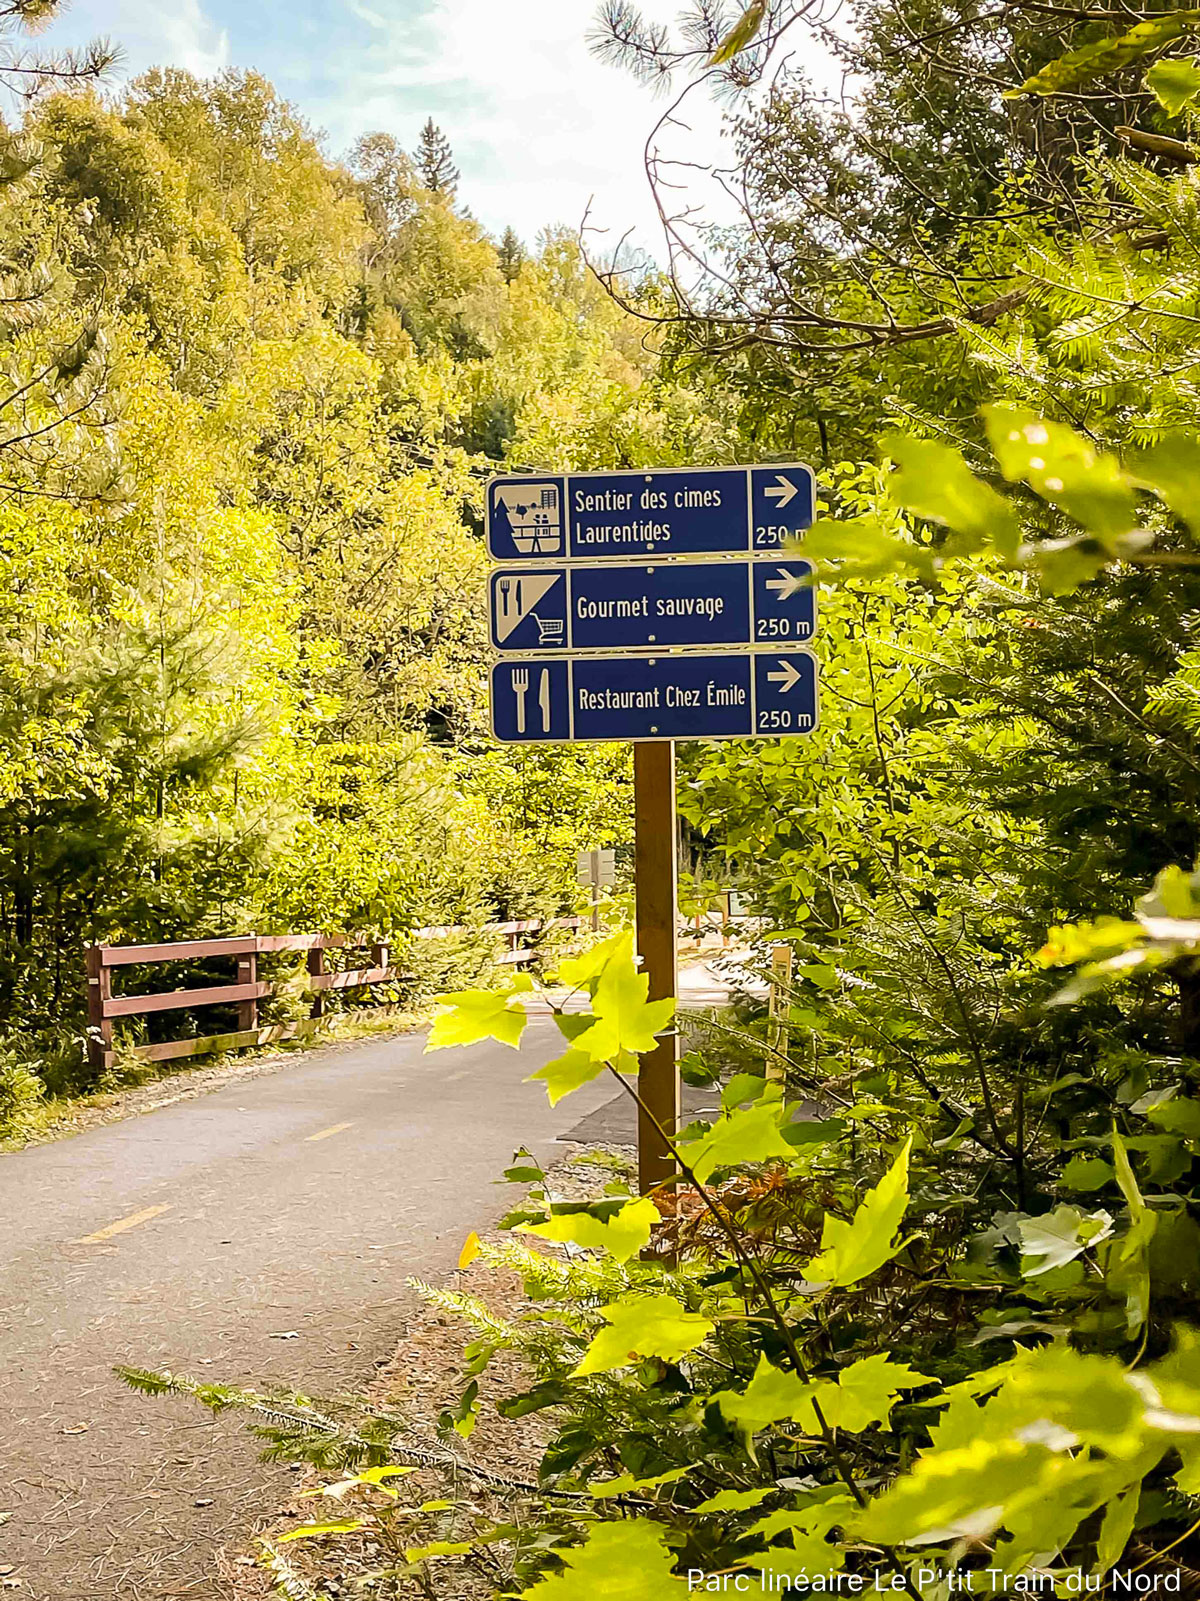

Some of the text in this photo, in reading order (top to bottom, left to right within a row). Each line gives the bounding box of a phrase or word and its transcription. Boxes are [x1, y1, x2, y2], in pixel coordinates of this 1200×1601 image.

[575, 486, 721, 512] Sentier des cimes
[576, 520, 671, 544] Laurentides
[756, 526, 788, 544] 250
[577, 596, 724, 621] Gourmet sauvage
[757, 619, 810, 636] 250 m
[579, 681, 746, 709] Restaurant Chez Émile
[759, 711, 812, 728] 250 m
